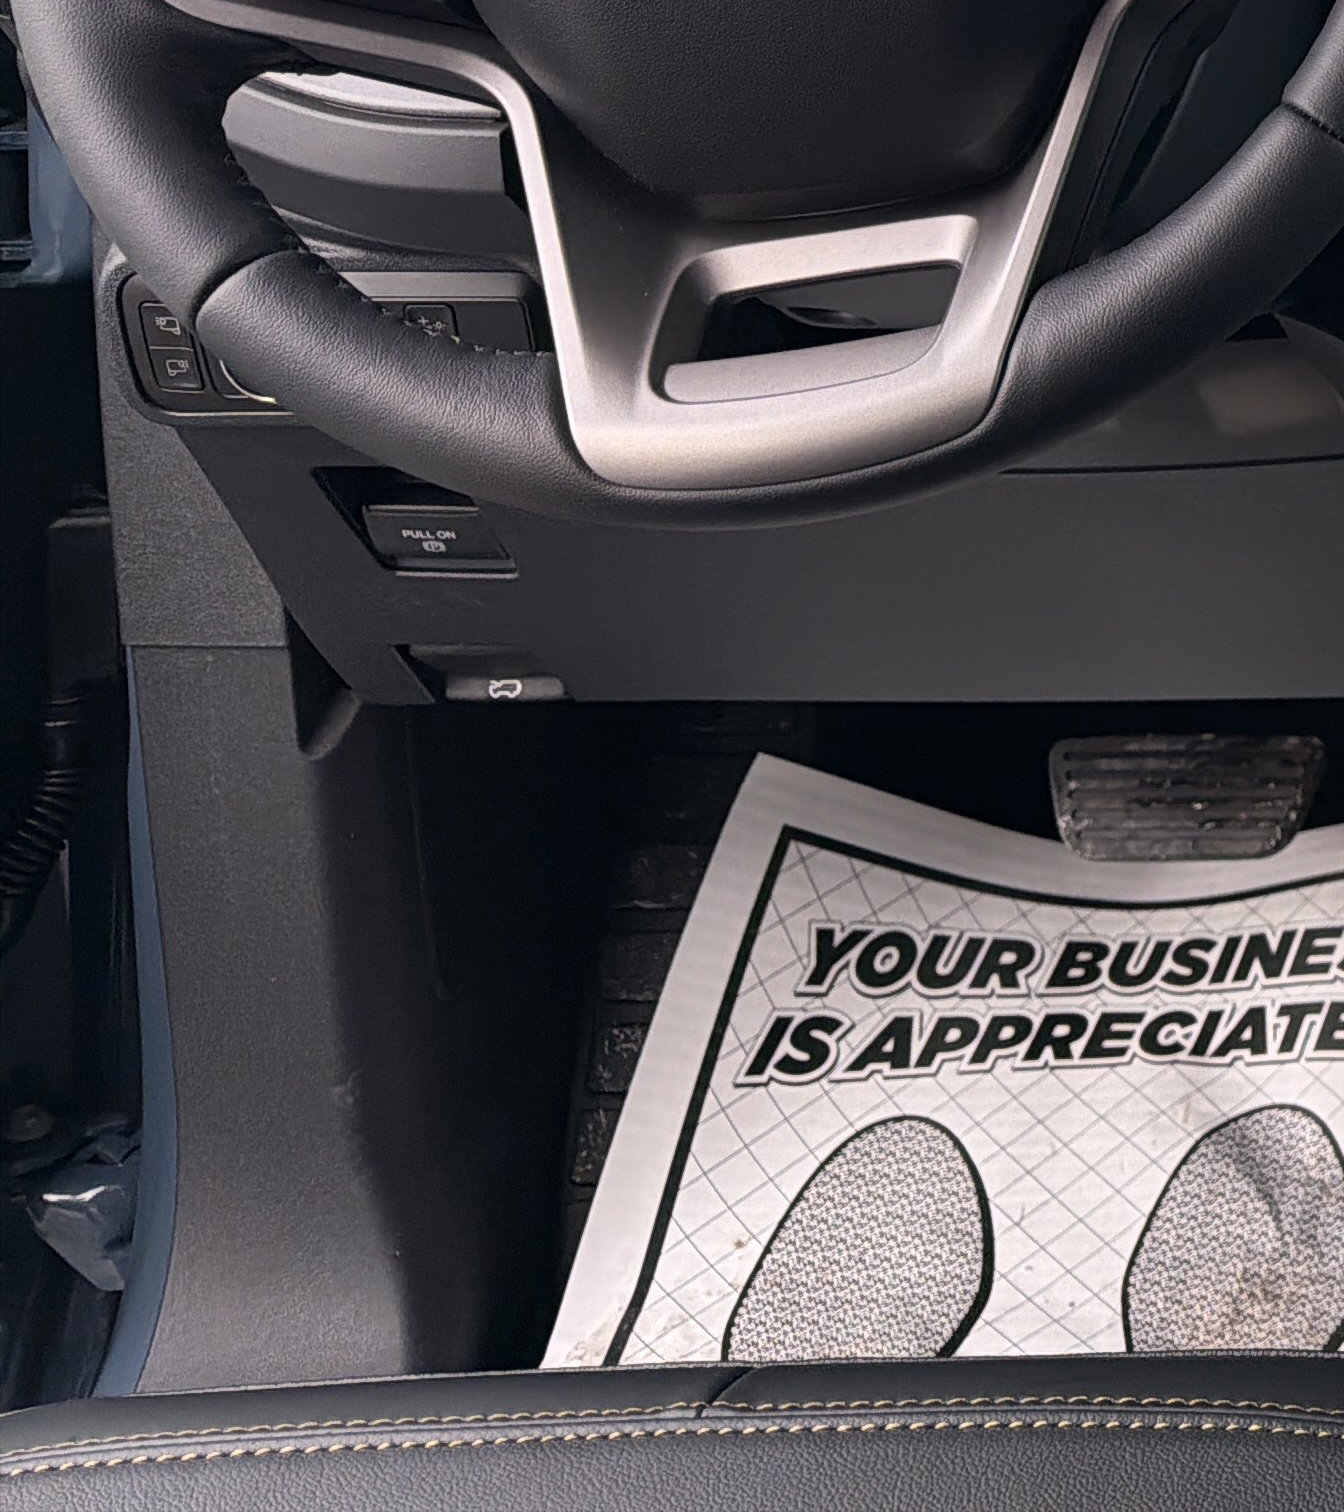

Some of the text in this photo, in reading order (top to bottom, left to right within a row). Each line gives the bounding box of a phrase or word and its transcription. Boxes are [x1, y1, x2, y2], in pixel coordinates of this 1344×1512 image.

[401, 529, 457, 540] PULL ON
[800, 924, 1040, 996] YOUR
[743, 1009, 840, 1080] IS
